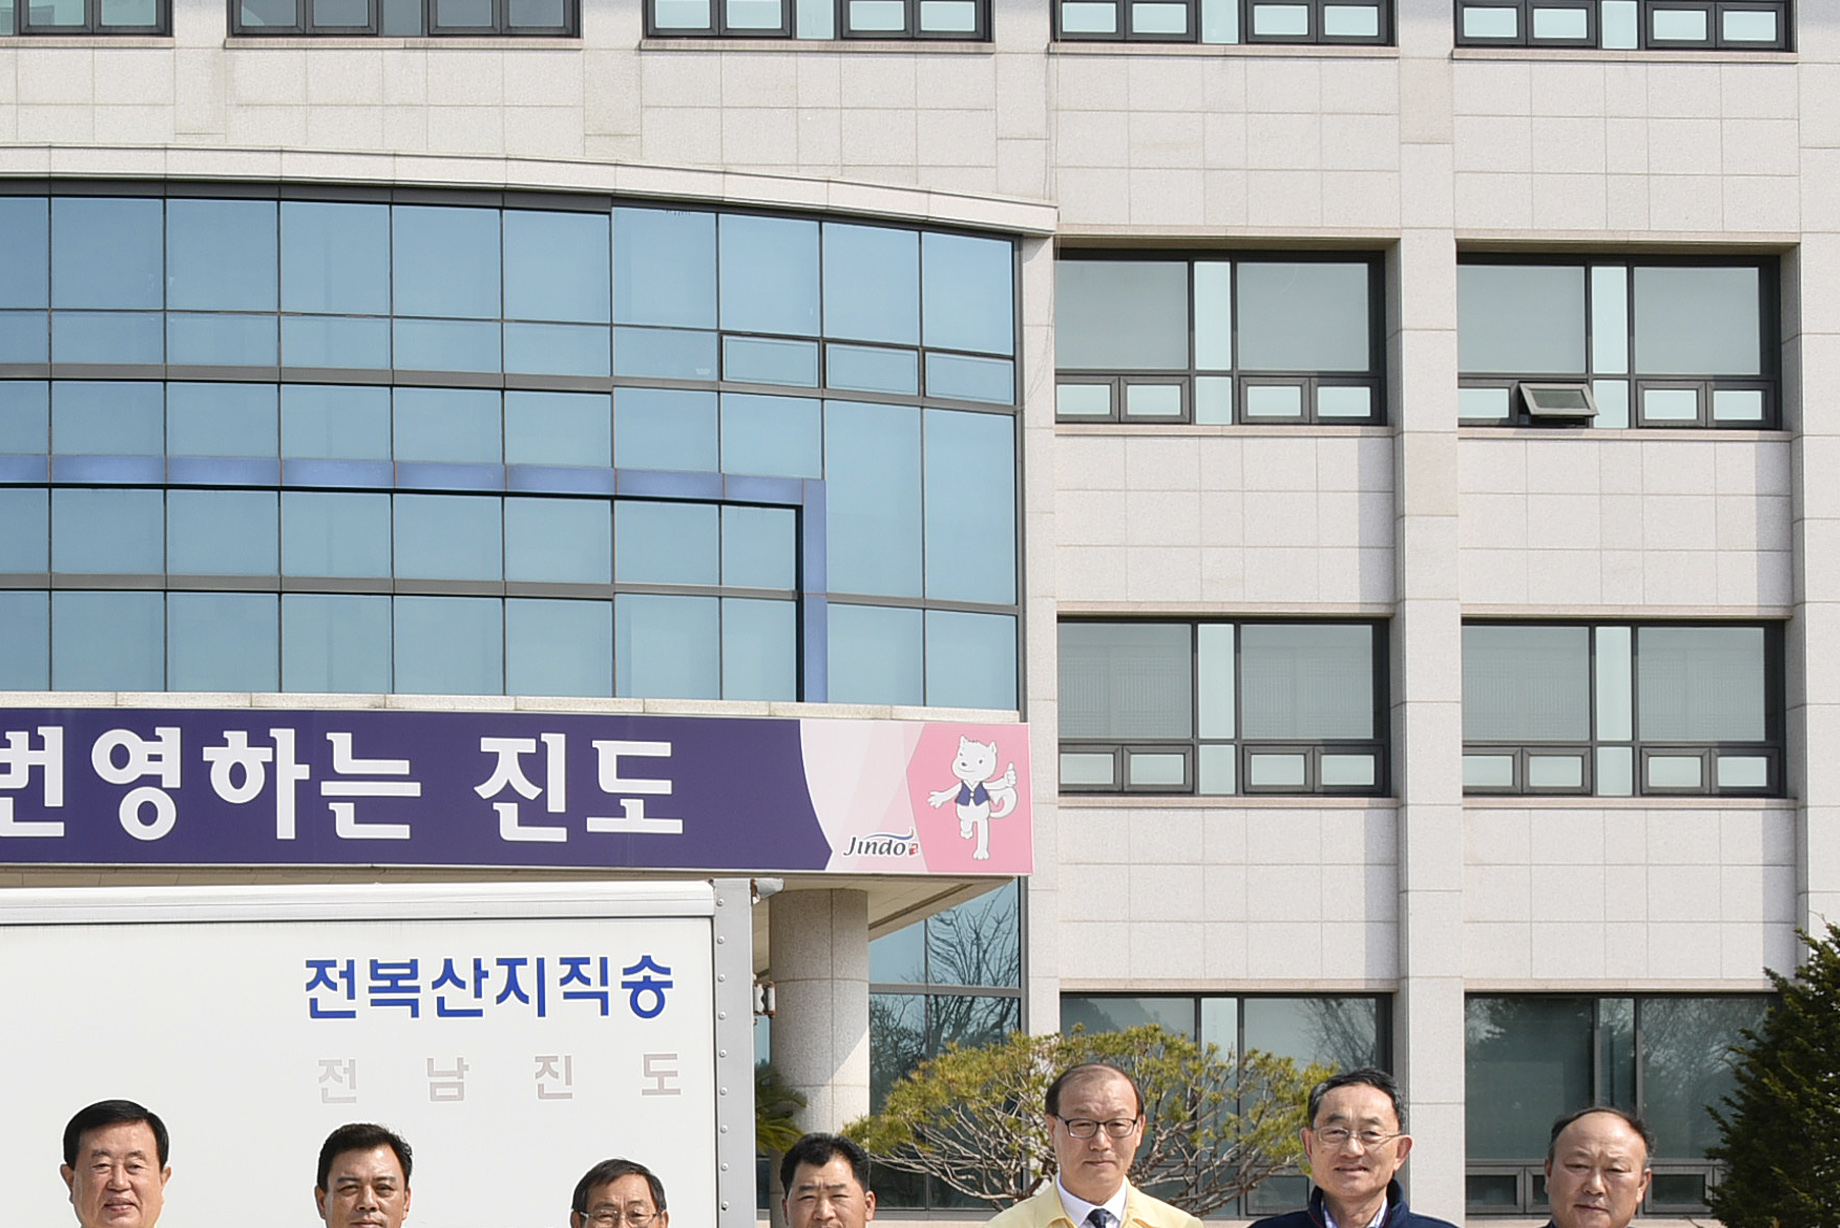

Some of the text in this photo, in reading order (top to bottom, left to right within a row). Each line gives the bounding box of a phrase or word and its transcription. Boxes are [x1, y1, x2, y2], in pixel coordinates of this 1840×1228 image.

[473, 732, 683, 842] 진도
[843, 836, 906, 856] Jindo
[305, 955, 674, 1019] 전복산지직송
